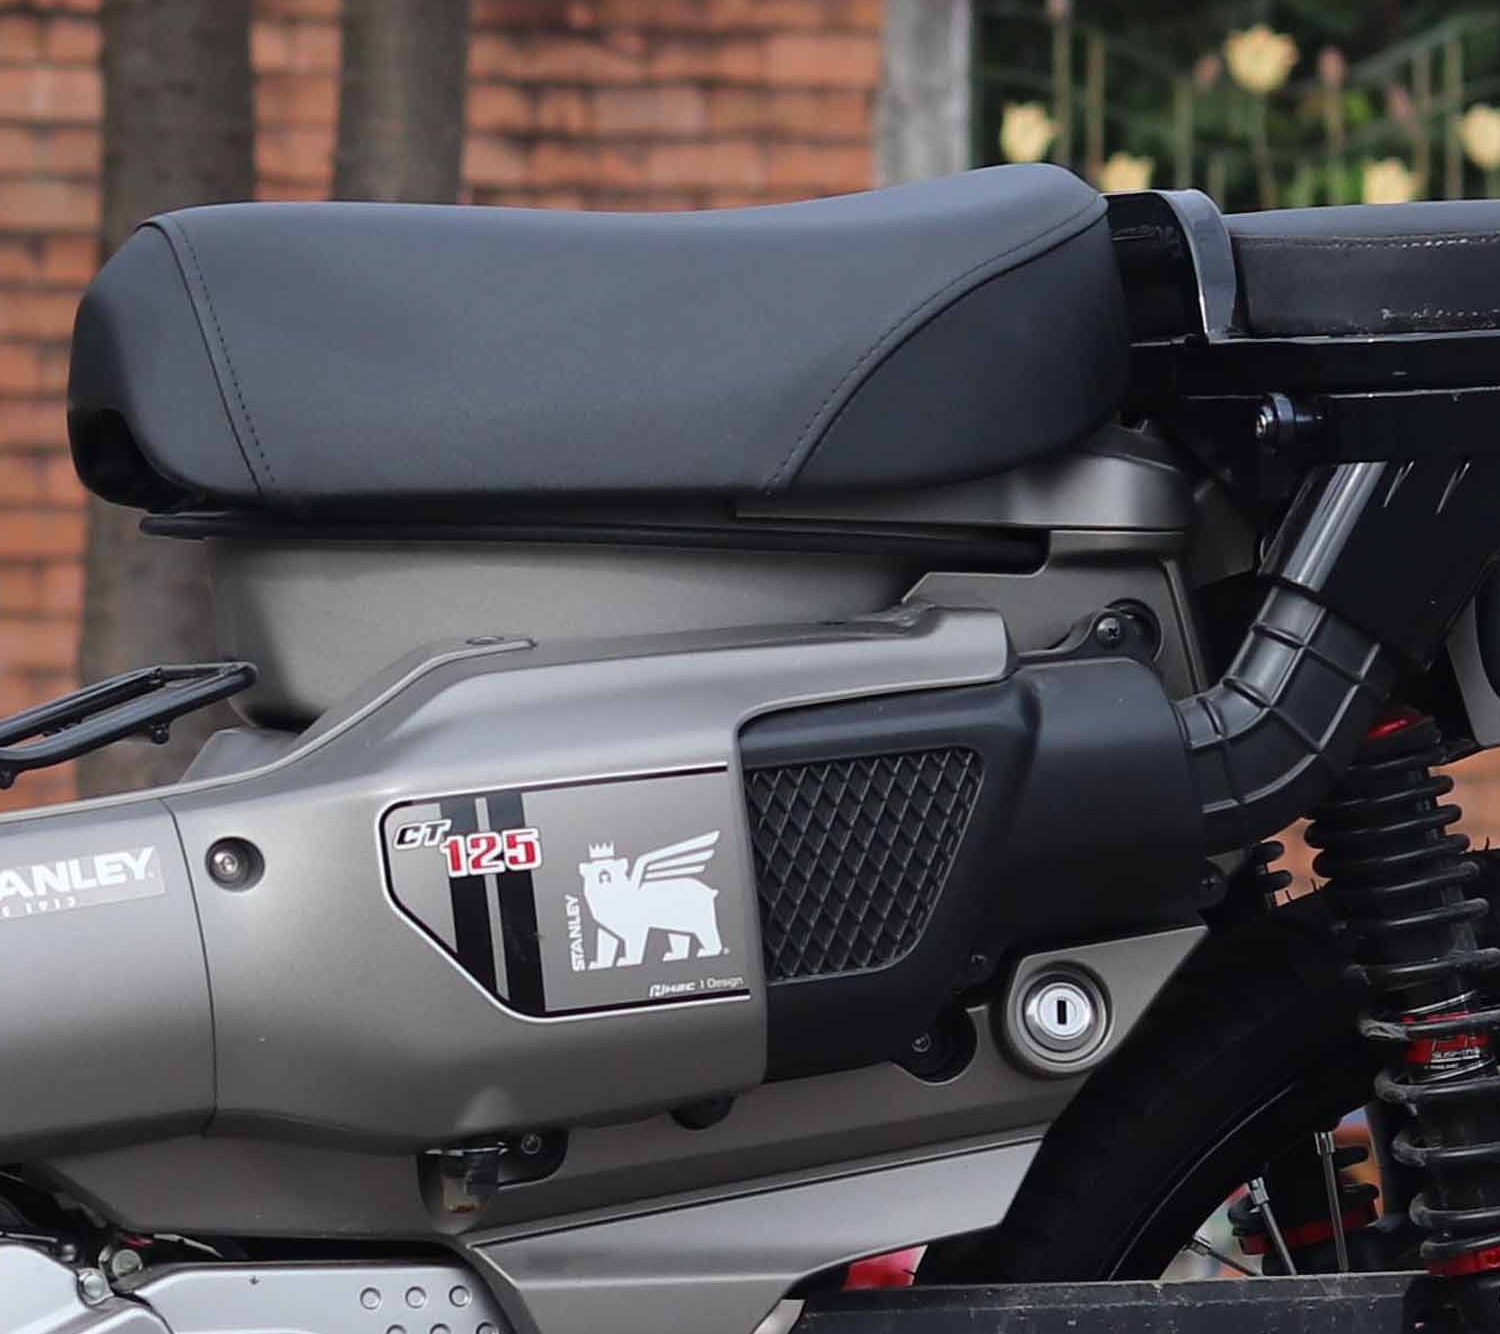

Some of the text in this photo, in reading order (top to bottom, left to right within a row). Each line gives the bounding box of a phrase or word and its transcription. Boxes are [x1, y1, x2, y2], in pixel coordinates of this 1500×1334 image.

[395, 819, 543, 878] CT 125
[565, 894, 587, 972] STANLEY
